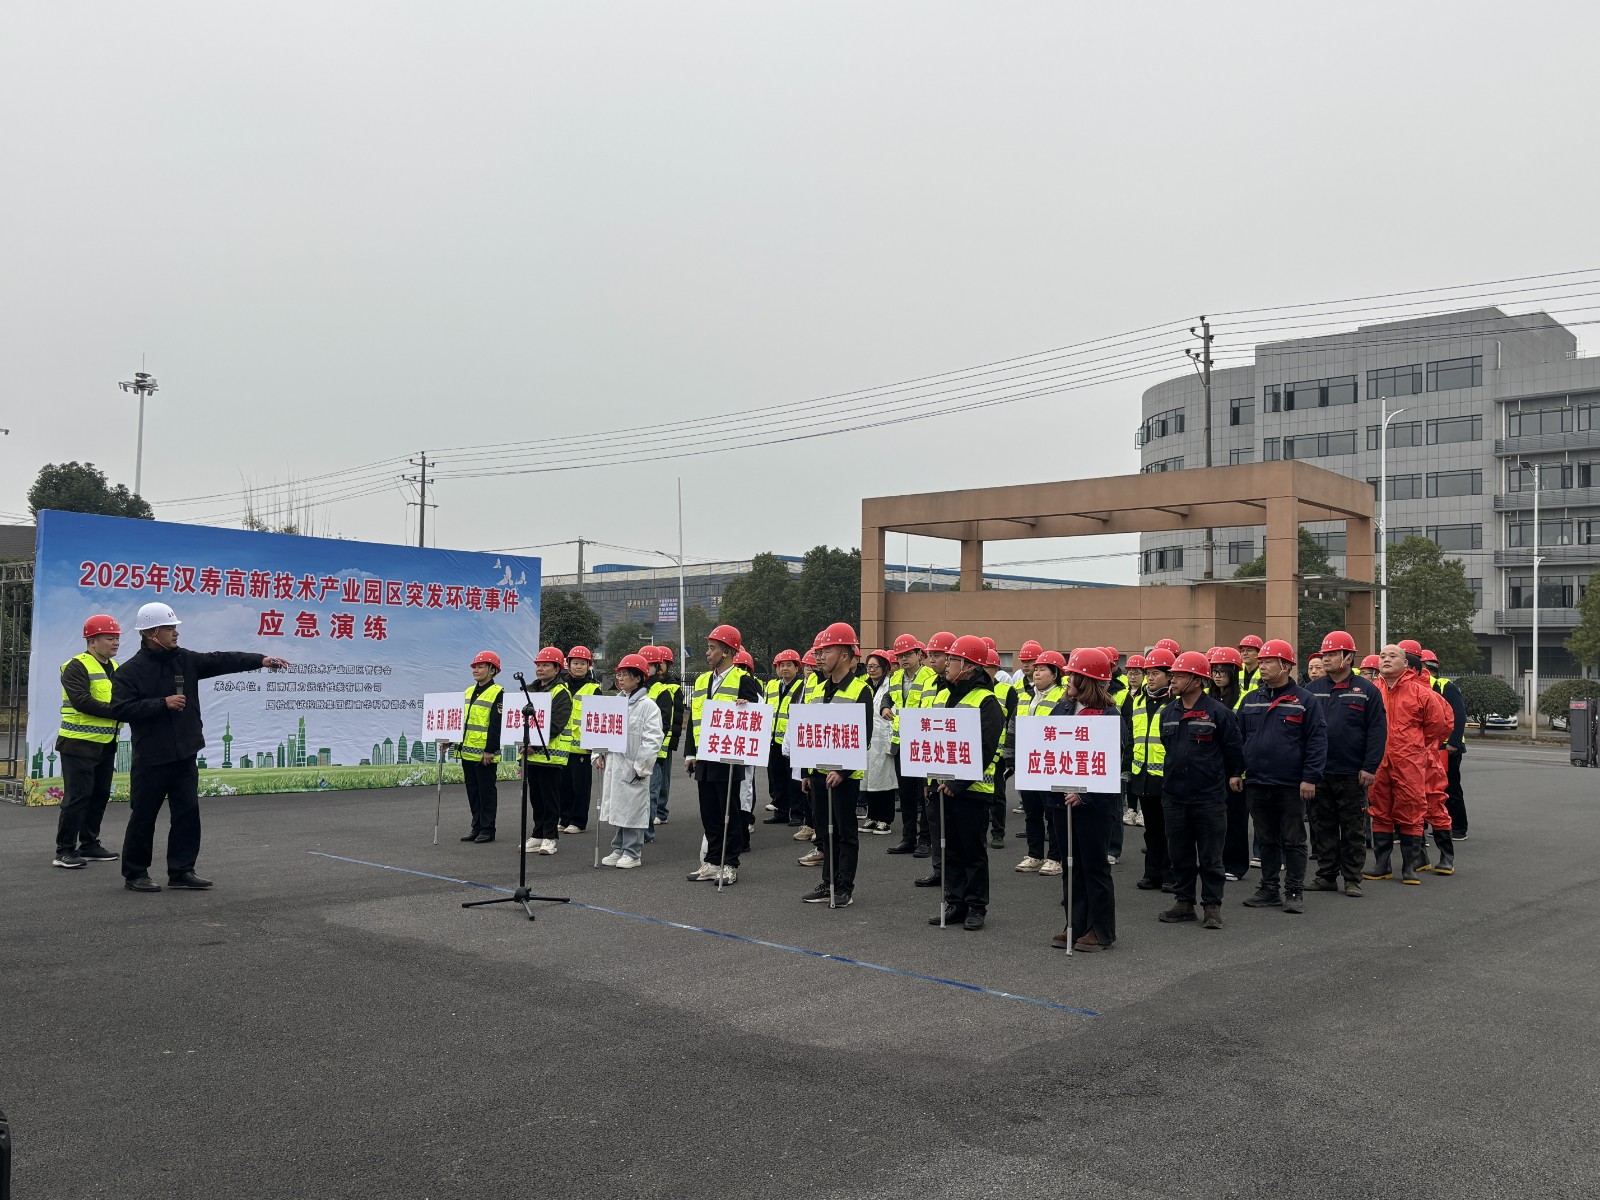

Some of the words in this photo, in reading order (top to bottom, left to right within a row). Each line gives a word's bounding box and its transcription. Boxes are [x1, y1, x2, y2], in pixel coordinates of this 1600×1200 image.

[79, 560, 520, 614] 2025年汉寿高新技术产业园区突发环境事件
[257, 610, 389, 641] 应急演练
[585, 713, 623, 736] 应急监测组
[709, 708, 763, 732] 应急疏散
[920, 717, 957, 733] 第二组
[707, 733, 759, 757] 安全保卫
[796, 722, 860, 749] 应急医疗救援组
[1043, 726, 1090, 742] 第一组
[909, 740, 972, 765] 应急处置组
[1027, 750, 1107, 776] 应急处置组
